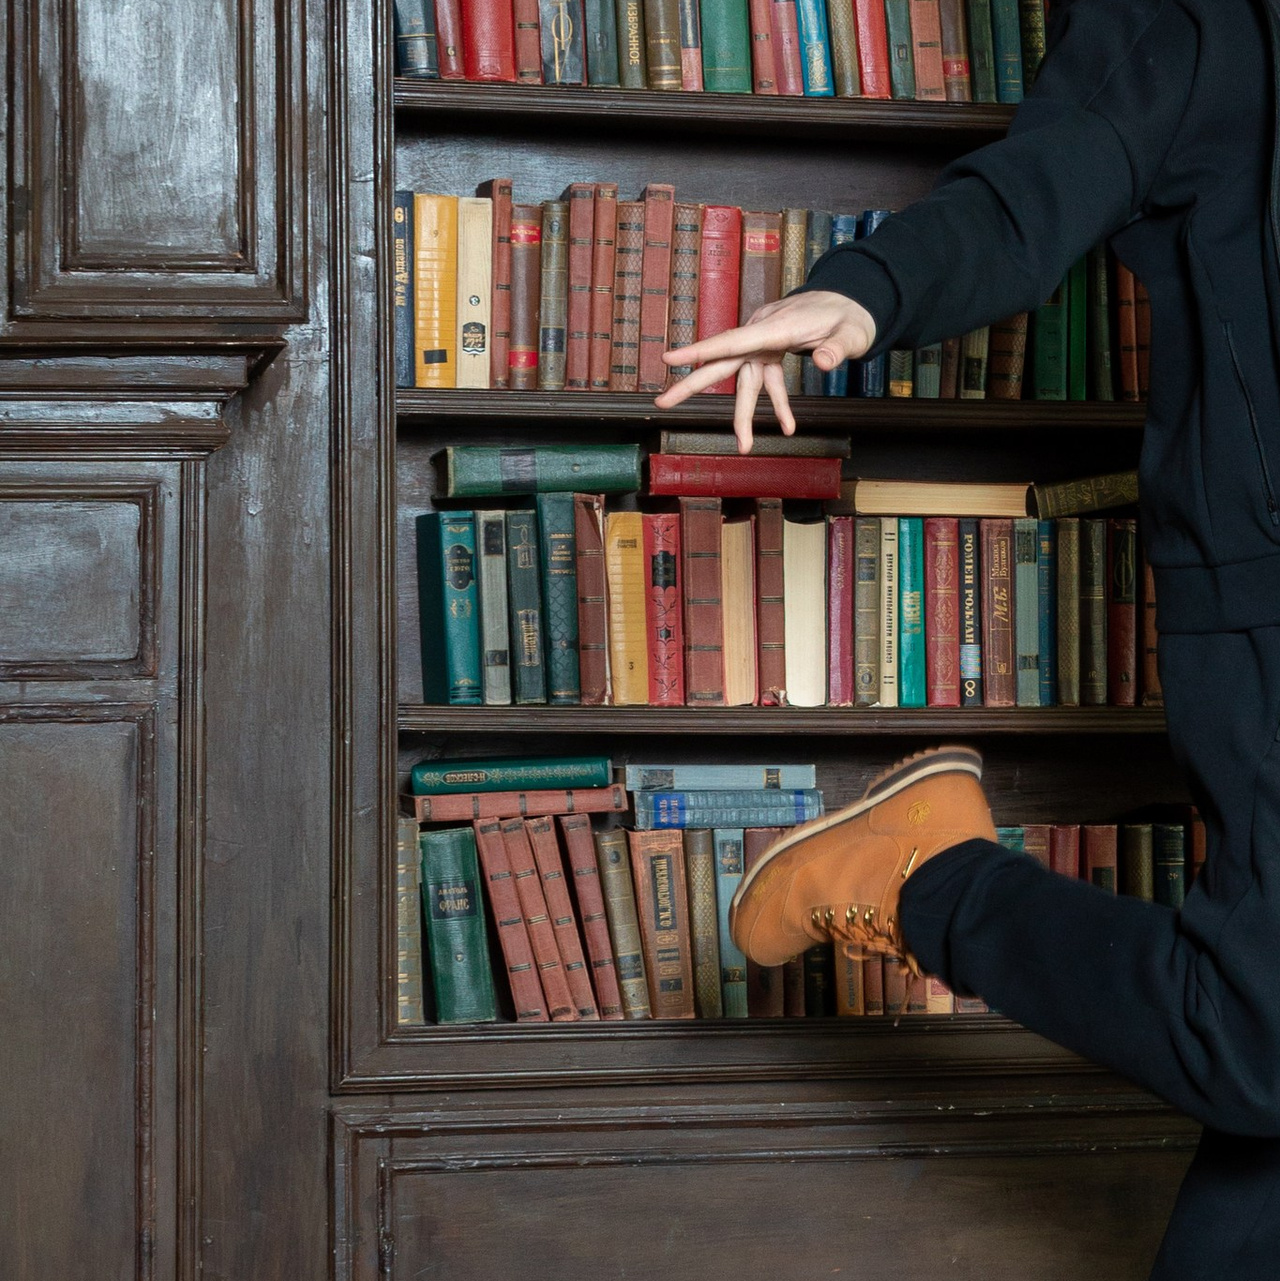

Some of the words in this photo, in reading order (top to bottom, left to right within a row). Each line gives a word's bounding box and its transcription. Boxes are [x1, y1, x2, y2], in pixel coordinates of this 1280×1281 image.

[628, 2, 640, 66] ИЗБРАННОЕ
[886, 552, 894, 585] КОРАБЛЕЙ
[964, 533, 974, 574] РОМЕН
[991, 542, 999, 578] Михаил
[999, 540, 1007, 578] Булгаков
[964, 577, 974, 644] РОЛЛАН
[993, 587, 1009, 623] М.Б.
[964, 679, 975, 698] 8
[438, 898, 470, 911] ФРАНС
